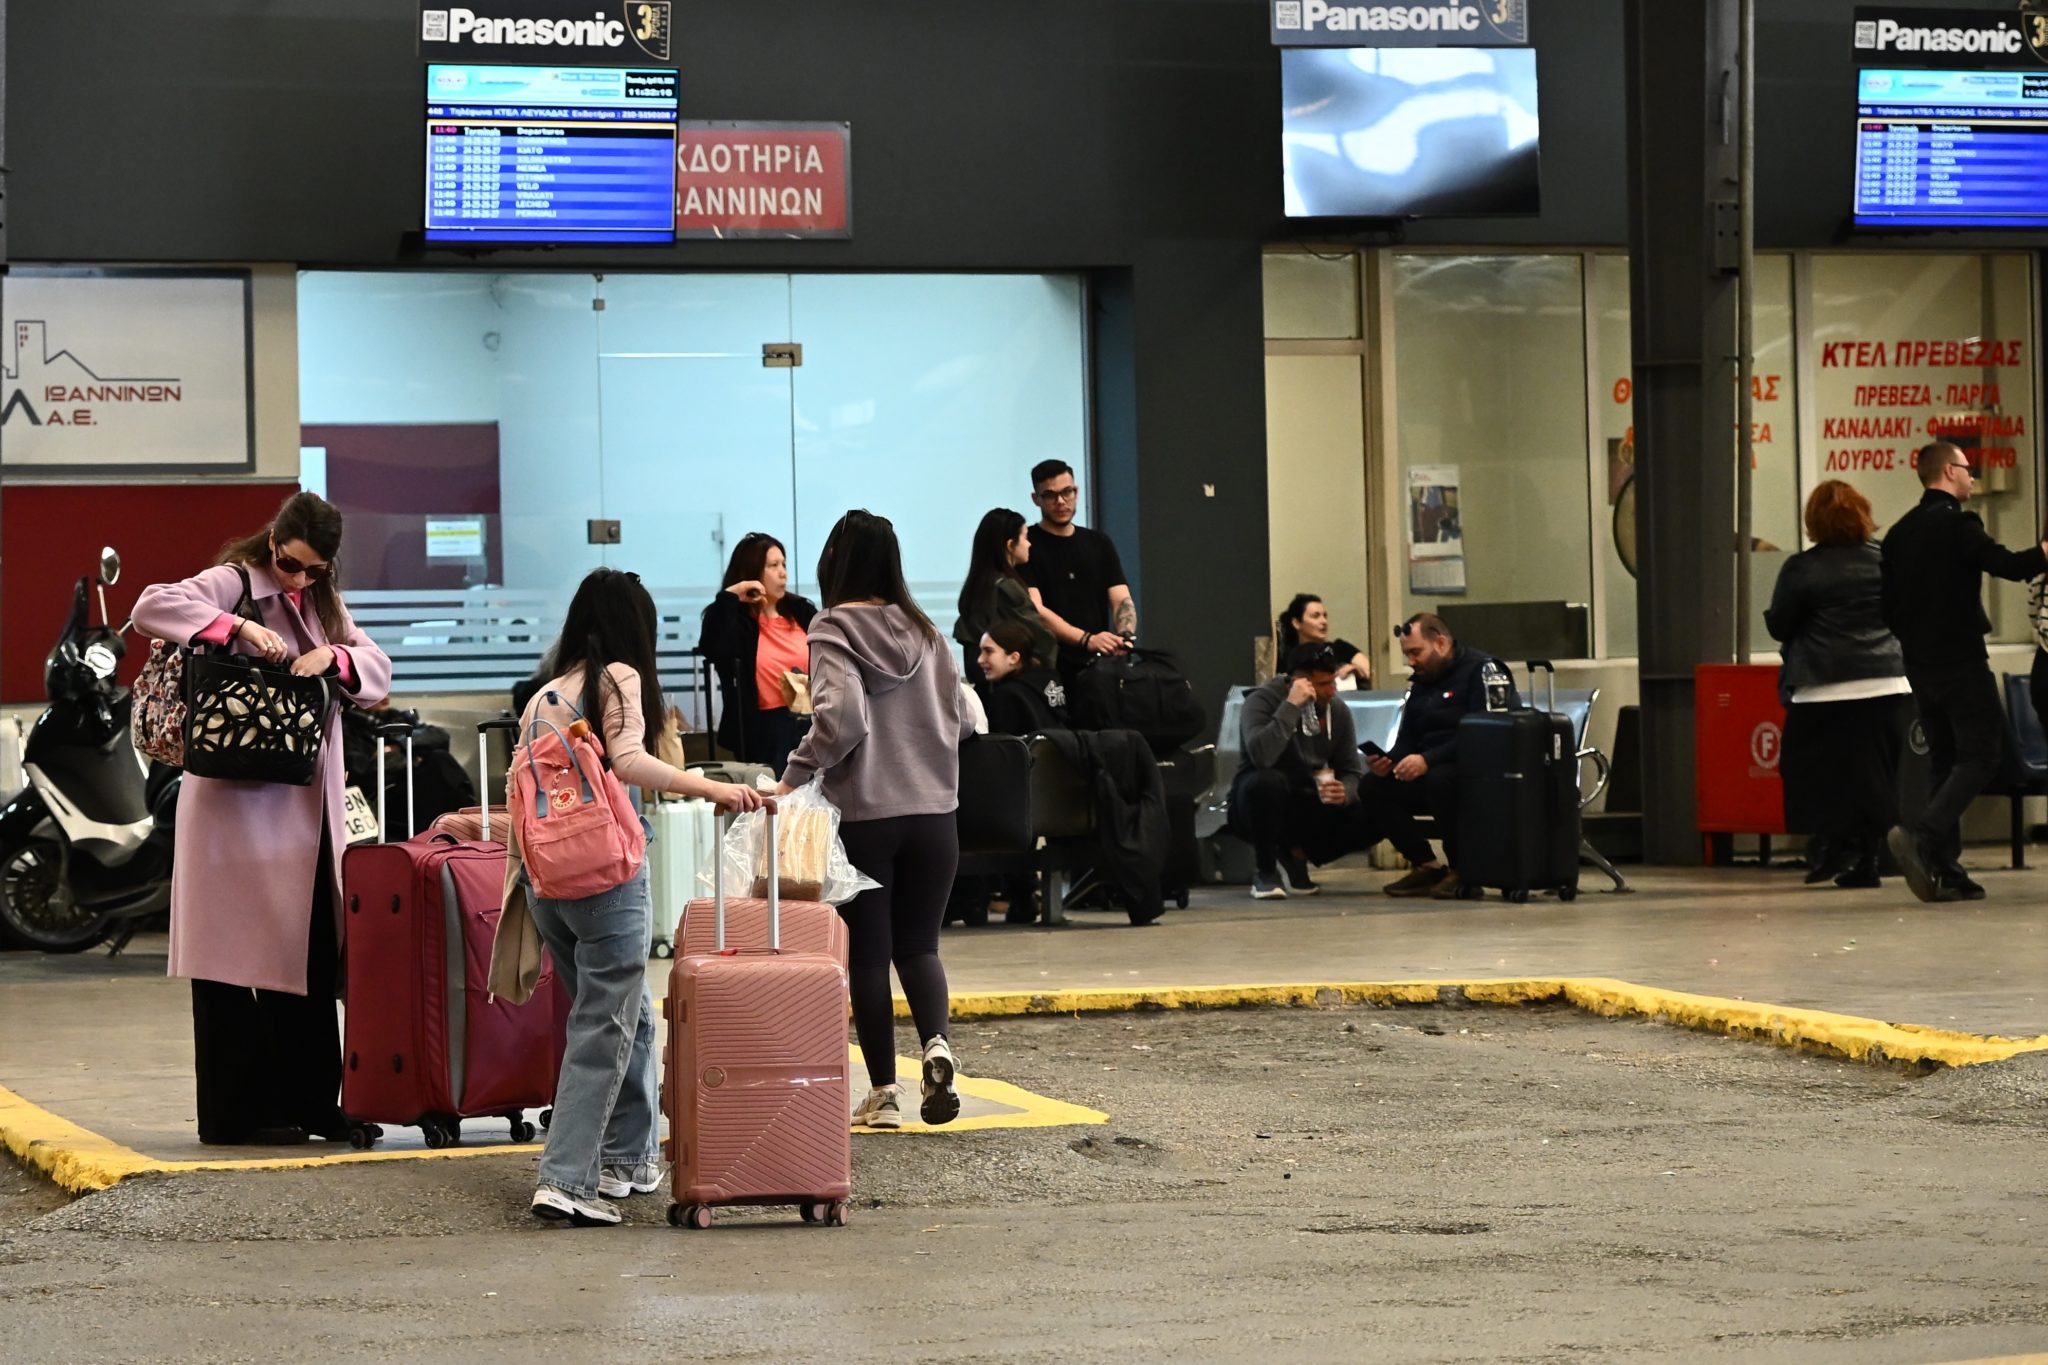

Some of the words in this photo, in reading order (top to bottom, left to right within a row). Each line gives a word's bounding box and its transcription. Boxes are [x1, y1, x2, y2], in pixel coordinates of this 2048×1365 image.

[449, 8, 625, 47] Panasonic
[636, 4, 652, 41] 3
[1302, 0, 1480, 31] Panasonic
[1877, 19, 2022, 53] Panasonic
[2032, 15, 2046, 48] 3
[677, 186, 823, 216] ΑΝΝΙΝΩΝ
[1822, 341, 1887, 368] ΚΤΕΛ
[1895, 341, 2023, 367] ΠΡΕΒΕΖΑΣ
[45, 386, 181, 401] ΙΩΑΝΝΙΝΩΝ
[1855, 385, 1932, 407] ΠΡΕΒΕΖΑ
[1947, 384, 2001, 406] ΠΑΡΓΑ
[46, 409, 97, 426] Α.Ε.
[1823, 417, 1913, 439] ΚΑΝΑΛΑΚΙ
[1825, 450, 1896, 472] ΛΟΥΡΟΣ
